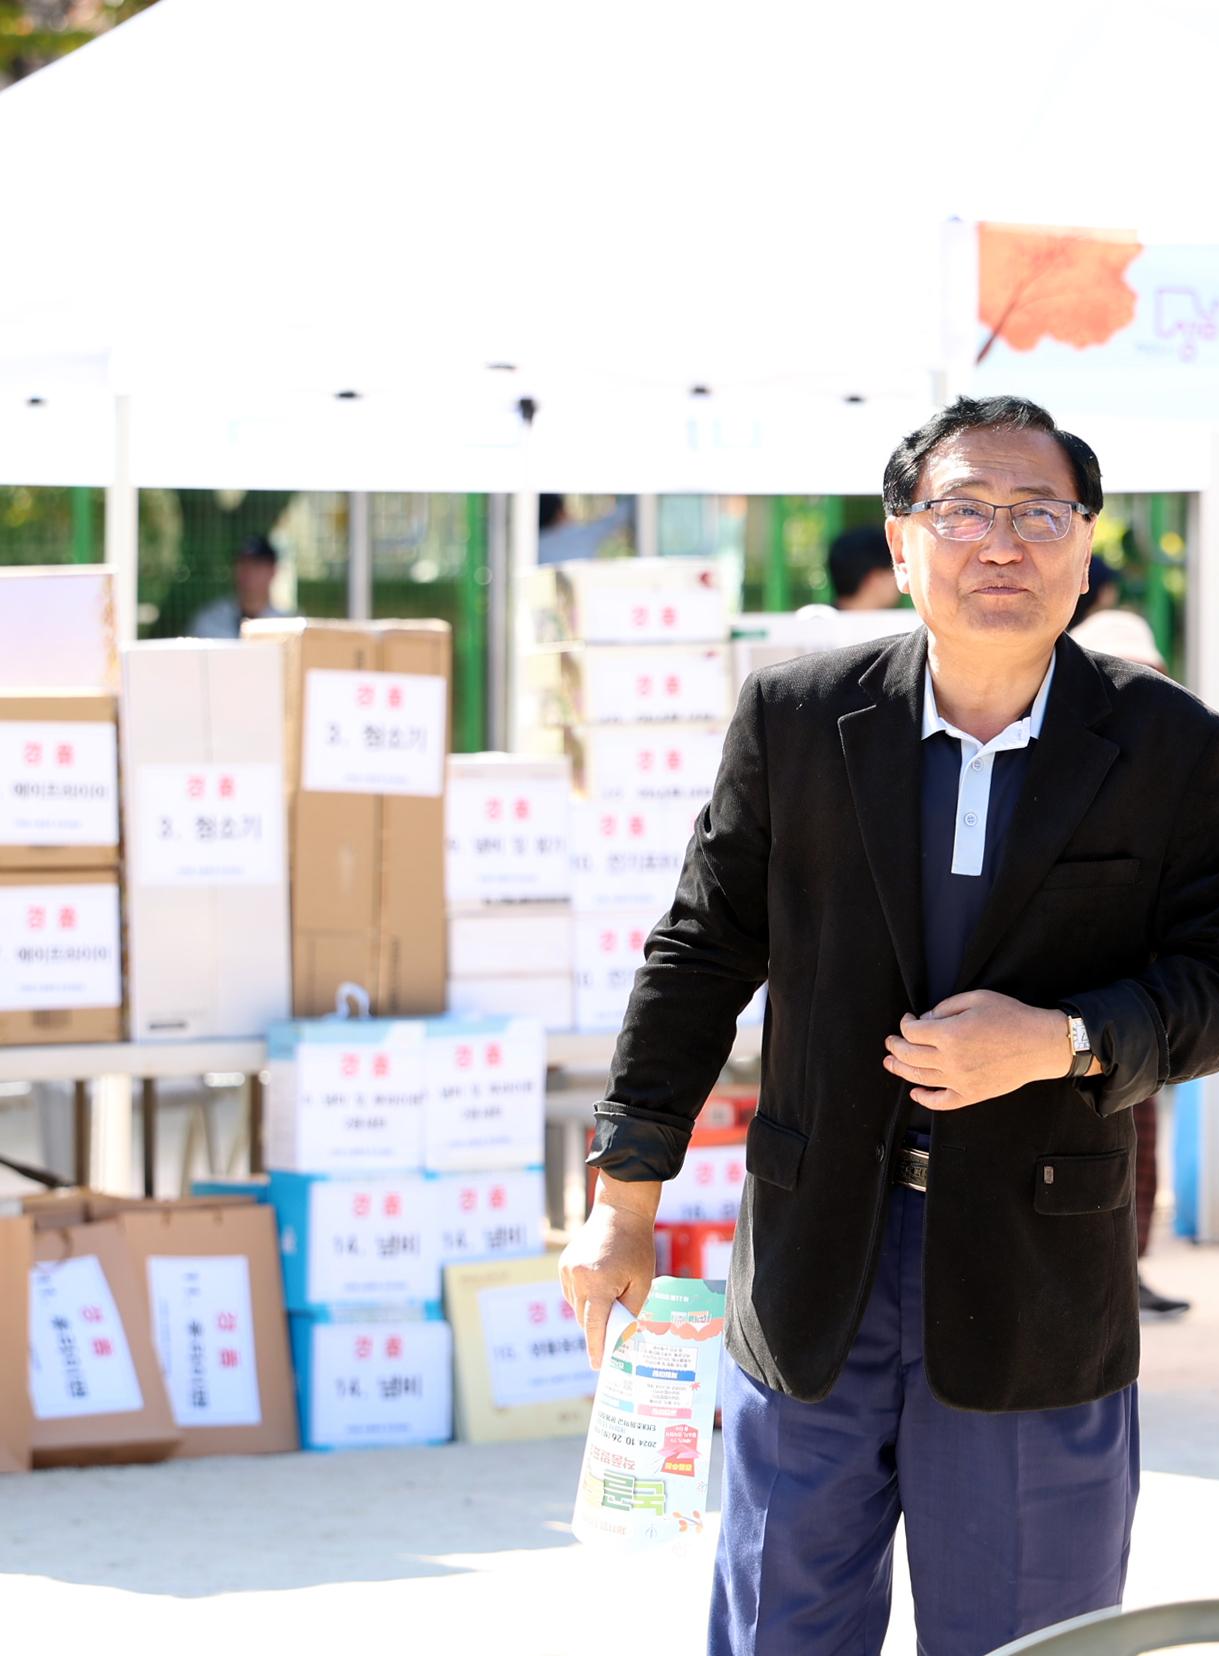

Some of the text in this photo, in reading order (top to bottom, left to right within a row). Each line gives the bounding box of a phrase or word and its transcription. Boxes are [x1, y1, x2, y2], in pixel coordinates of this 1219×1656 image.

[376, 1233, 421, 1259] 냄비
[379, 1373, 423, 1400] 냄비
[617, 1418, 656, 1431] 단대초등학교
